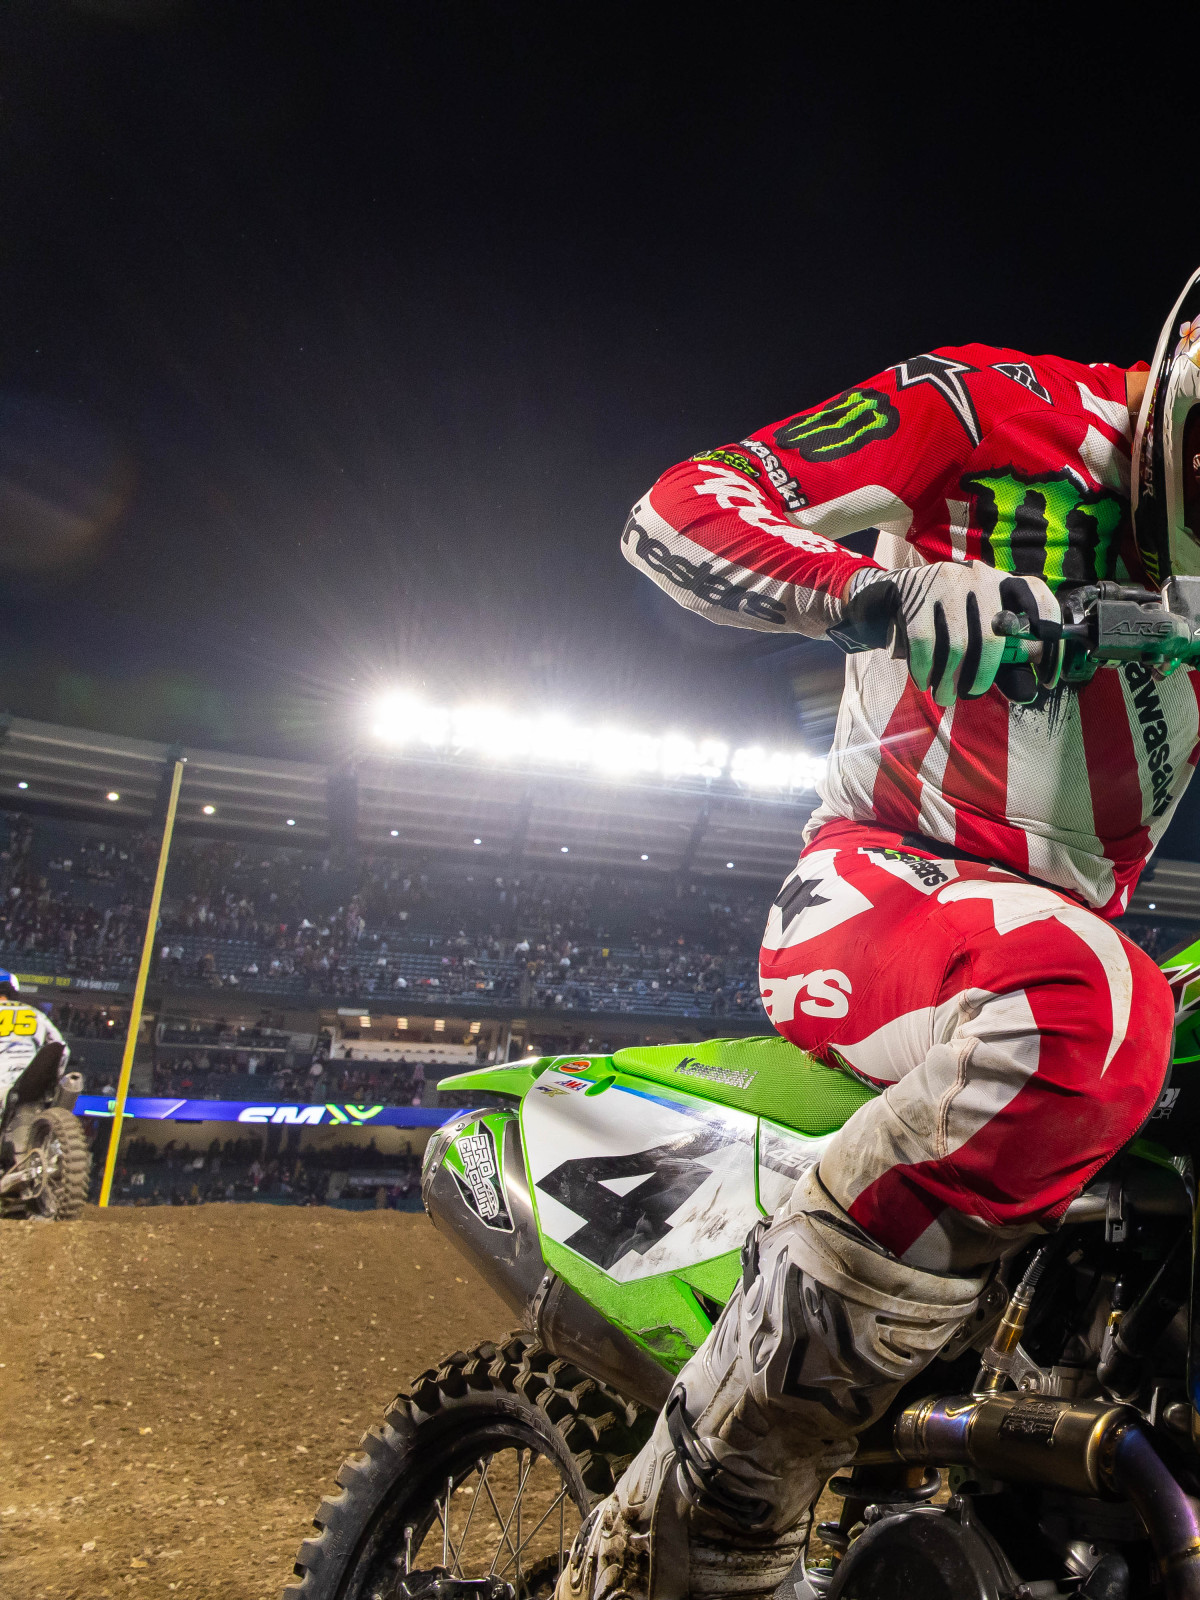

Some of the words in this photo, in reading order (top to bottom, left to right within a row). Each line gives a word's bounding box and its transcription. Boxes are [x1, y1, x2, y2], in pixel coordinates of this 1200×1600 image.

[1102, 620, 1173, 637] ARC
[457, 1137, 494, 1219] CIRCUIT
[471, 1135, 496, 1179] PRO
[535, 1130, 750, 1272] 4
